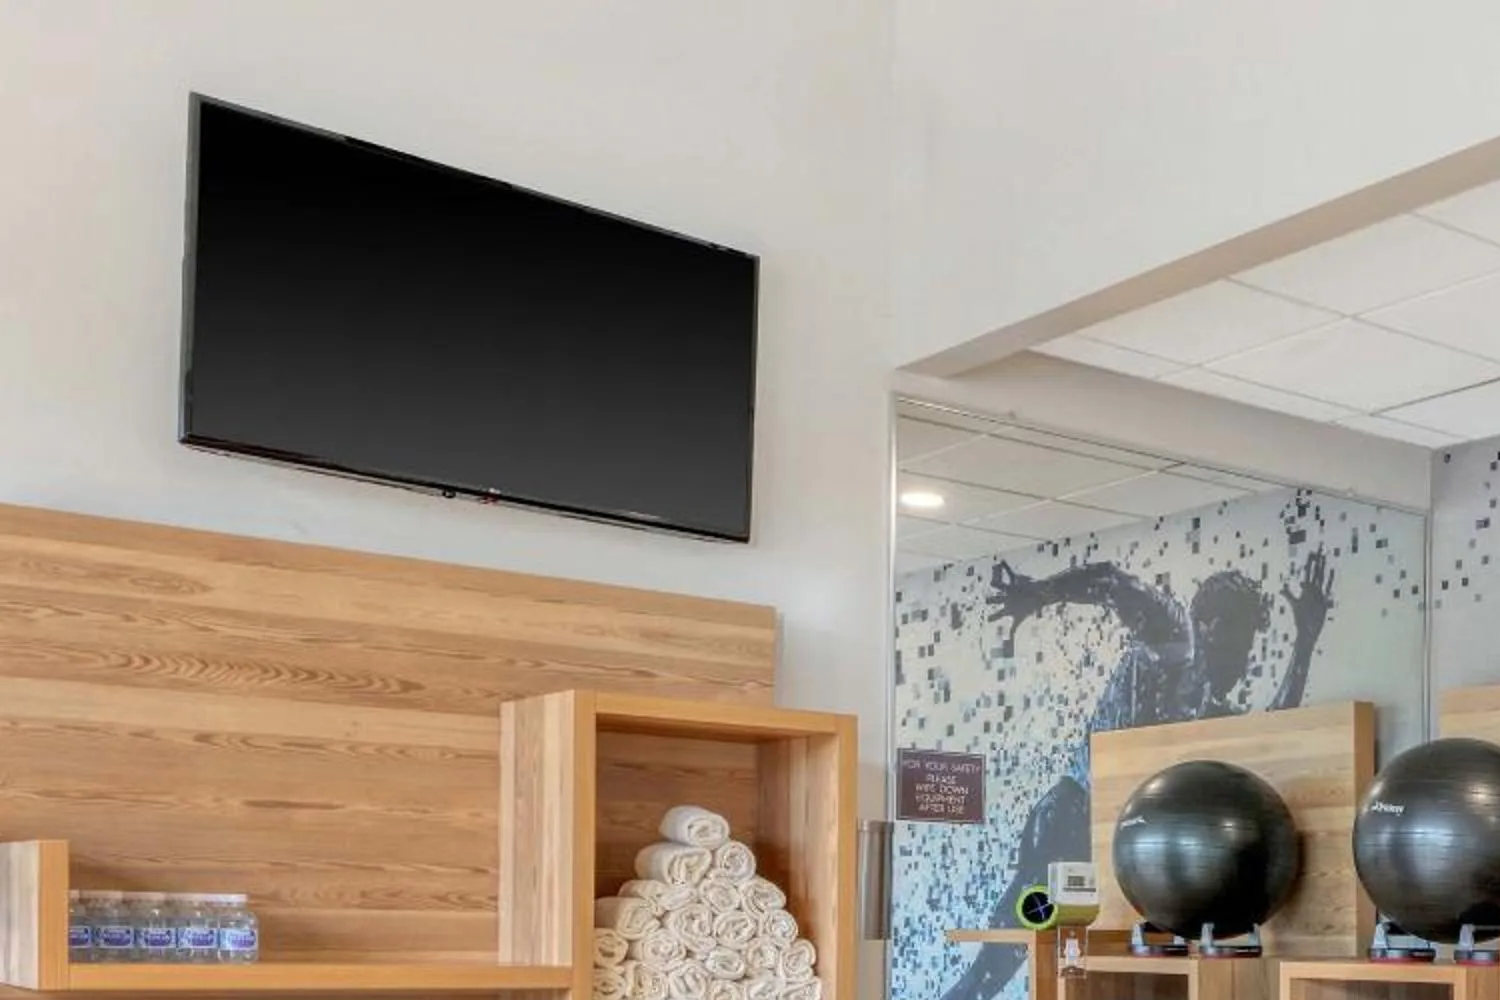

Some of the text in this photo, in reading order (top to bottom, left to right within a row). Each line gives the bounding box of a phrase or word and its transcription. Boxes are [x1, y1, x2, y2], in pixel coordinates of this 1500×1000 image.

[926, 773, 958, 785] PLEASE
[915, 782, 969, 795] WIPE DOWN
[915, 793, 966, 805] EQUIPMENT
[918, 803, 945, 813] AFTER
